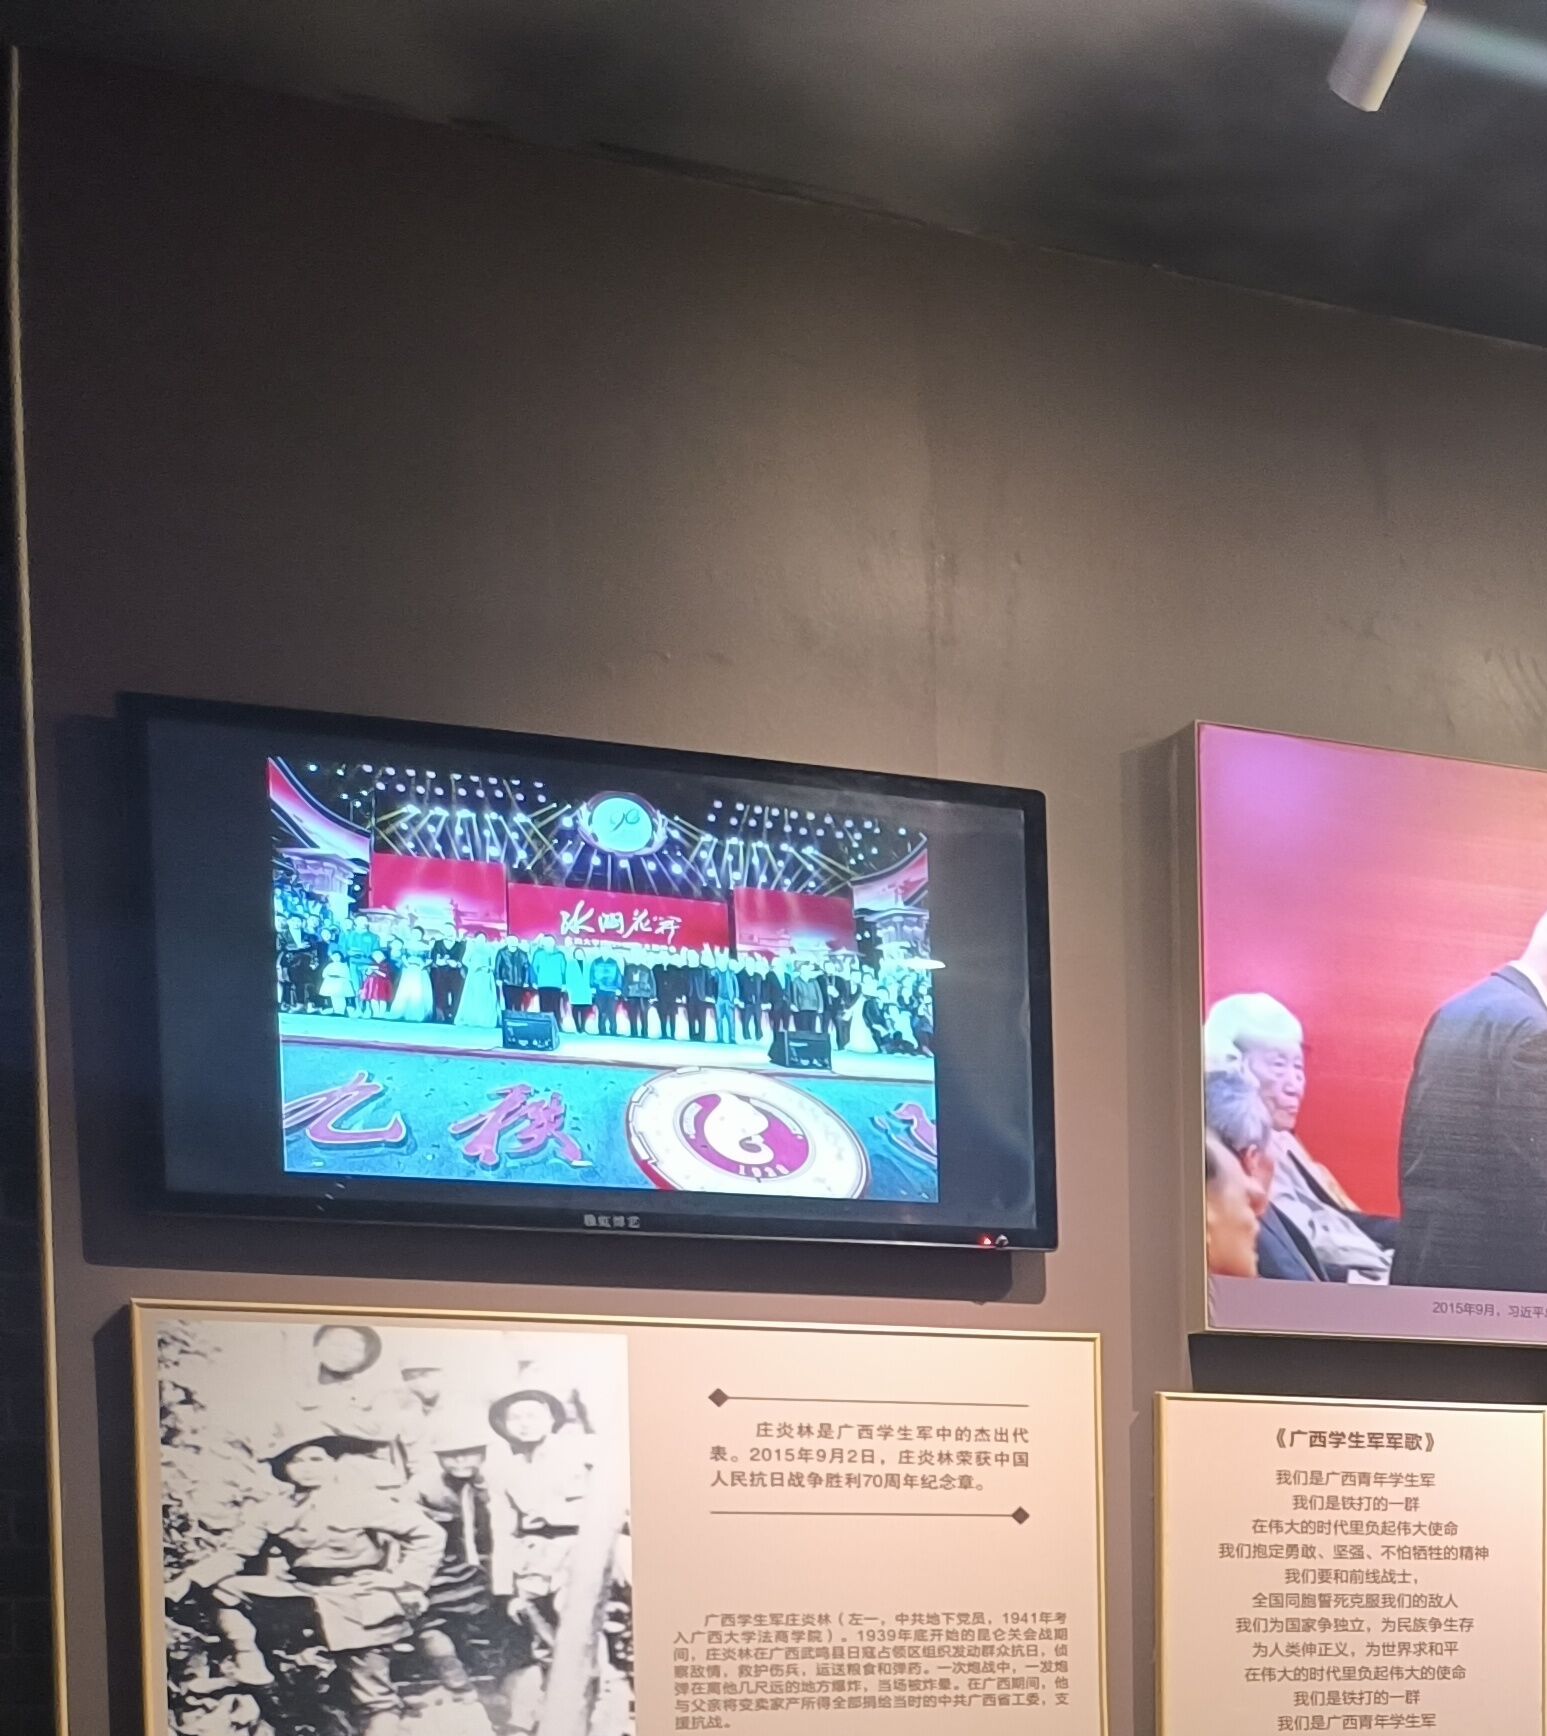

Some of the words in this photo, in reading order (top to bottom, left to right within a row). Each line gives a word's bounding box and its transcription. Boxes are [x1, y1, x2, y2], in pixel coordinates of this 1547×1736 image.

[756, 1421, 1030, 1444] 庄炎林是广西学生军中的杰出代
[1275, 1427, 1435, 1452] 《广西学生军军歌》
[709, 1445, 1029, 1468] 表。2015年9月2日，庄炎林荣获中国
[710, 1470, 984, 1491] 人民抗日战争胜利70周年纪念章。
[1276, 1468, 1436, 1487] 我们是广西青年学生军
[1292, 1494, 1420, 1512] 我们是铁打的一群
[1252, 1518, 1459, 1537] 在伟大的时代里负起伟大使命
[1218, 1543, 1490, 1561] 我们抱定勇敢、坚强、不怕牺牲的精神
[1285, 1568, 1419, 1585] 我们要和前线战士，
[1252, 1592, 1458, 1609] 全国同胞誓死克服我们的敌人
[1235, 1617, 1475, 1633] 我们为国家争独立，为民族争生存
[1252, 1641, 1459, 1658] 为人类伸正义，为世界求和平
[1244, 1665, 1467, 1682] 在伟大的时代里负起伟大的使命
[1293, 1690, 1421, 1707] 我们是铁打的一群
[675, 1715, 731, 1730] 援抗战。
[1277, 1713, 1437, 1732] 我们是广西青年学生军
